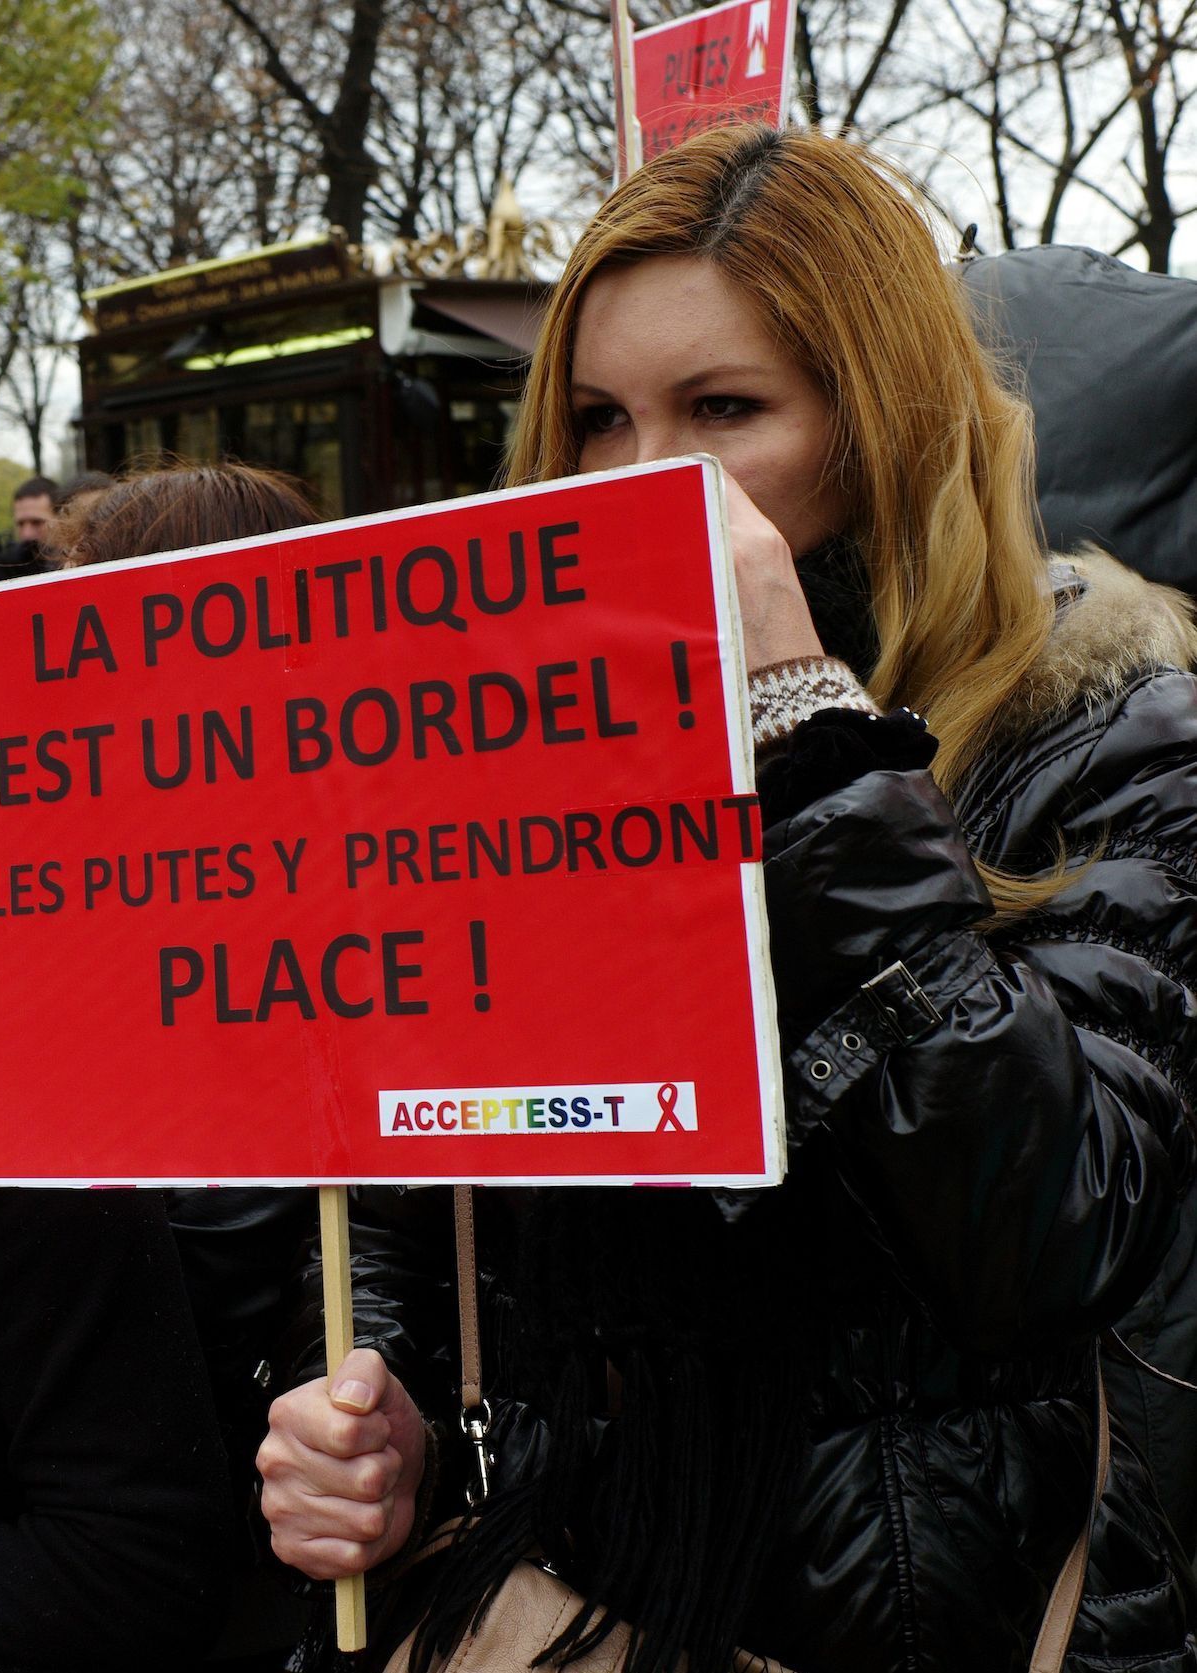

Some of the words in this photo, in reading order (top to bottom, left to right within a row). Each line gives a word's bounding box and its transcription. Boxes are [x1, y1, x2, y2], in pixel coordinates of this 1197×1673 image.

[663, 36, 730, 96] PUTES
[32, 605, 118, 683] LA
[143, 521, 587, 667] POLITIQUE
[141, 706, 255, 790] UN
[285, 656, 638, 774] BORDEL
[670, 640, 696, 731] !
[84, 843, 256, 910] PUTES
[273, 837, 307, 894] Y
[345, 796, 760, 889] PRENDRONT
[159, 930, 429, 1027] PLACE
[469, 920, 491, 1013] !
[391, 1096, 625, 1132] ACCEPTESS-T
